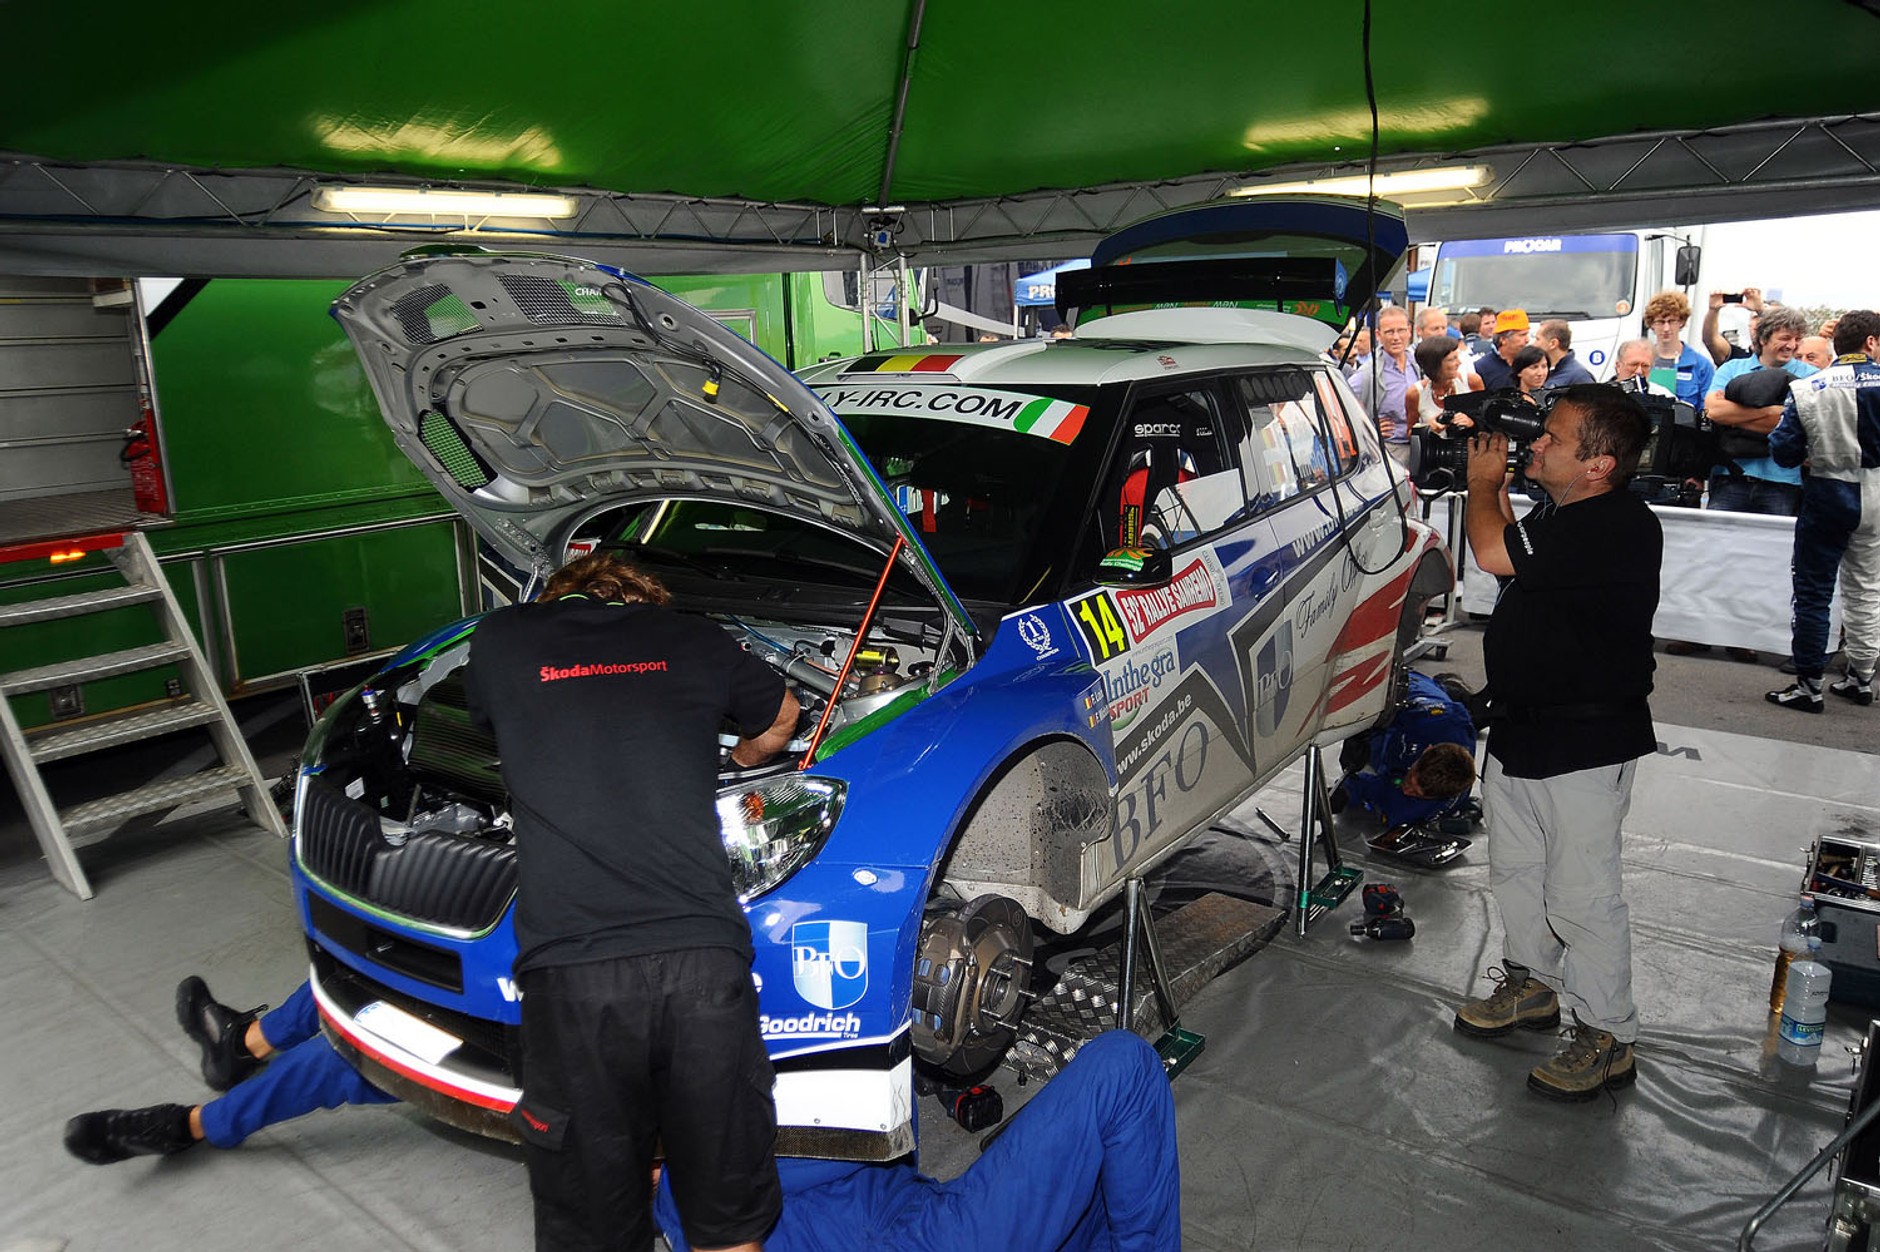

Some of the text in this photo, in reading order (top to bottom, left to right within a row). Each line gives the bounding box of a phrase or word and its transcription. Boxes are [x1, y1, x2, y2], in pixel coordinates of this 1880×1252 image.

[1079, 594, 1125, 659] 14
[539, 660, 668, 682] ŠkodaMotorsport
[1109, 686, 1150, 722] SPORT
[1111, 721, 1210, 878] BFO
[793, 946, 867, 979] BFO
